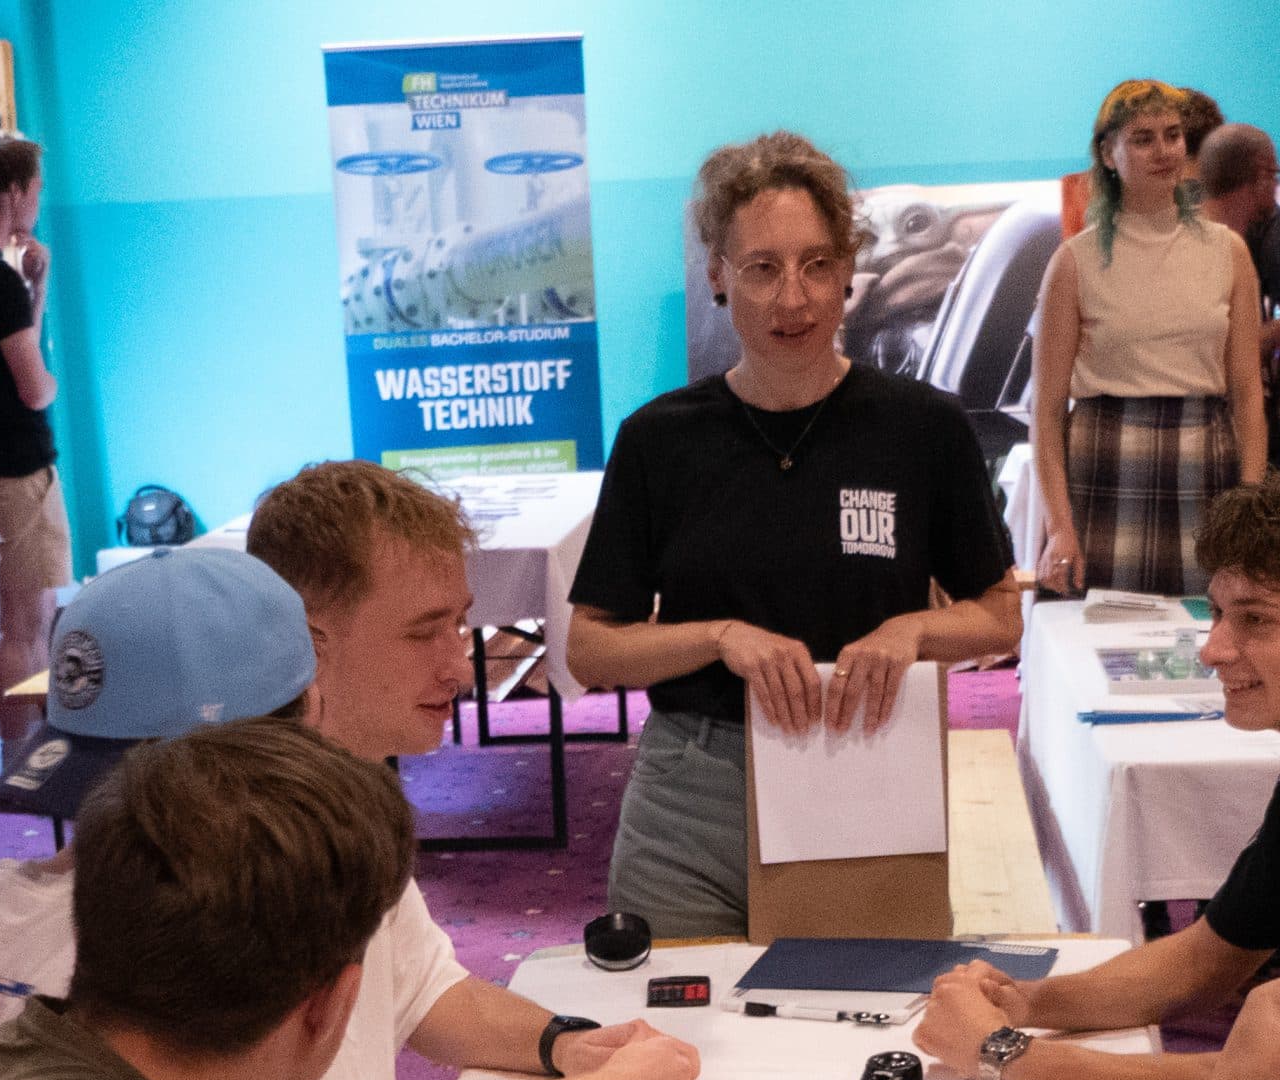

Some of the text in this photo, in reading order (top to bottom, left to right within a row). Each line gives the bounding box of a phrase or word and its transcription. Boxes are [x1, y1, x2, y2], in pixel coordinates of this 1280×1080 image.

[414, 91, 506, 109] TECHNIKUM
[415, 113, 458, 128] WIEN
[374, 327, 570, 350] DUALES BACHELOR-STUDIUM
[375, 359, 572, 401] WASSERSTOFF
[418, 395, 534, 431] TECHNIK
[840, 488, 897, 512] CHANGE
[840, 508, 895, 548] OUR
[841, 541, 897, 559] TOMORROW
